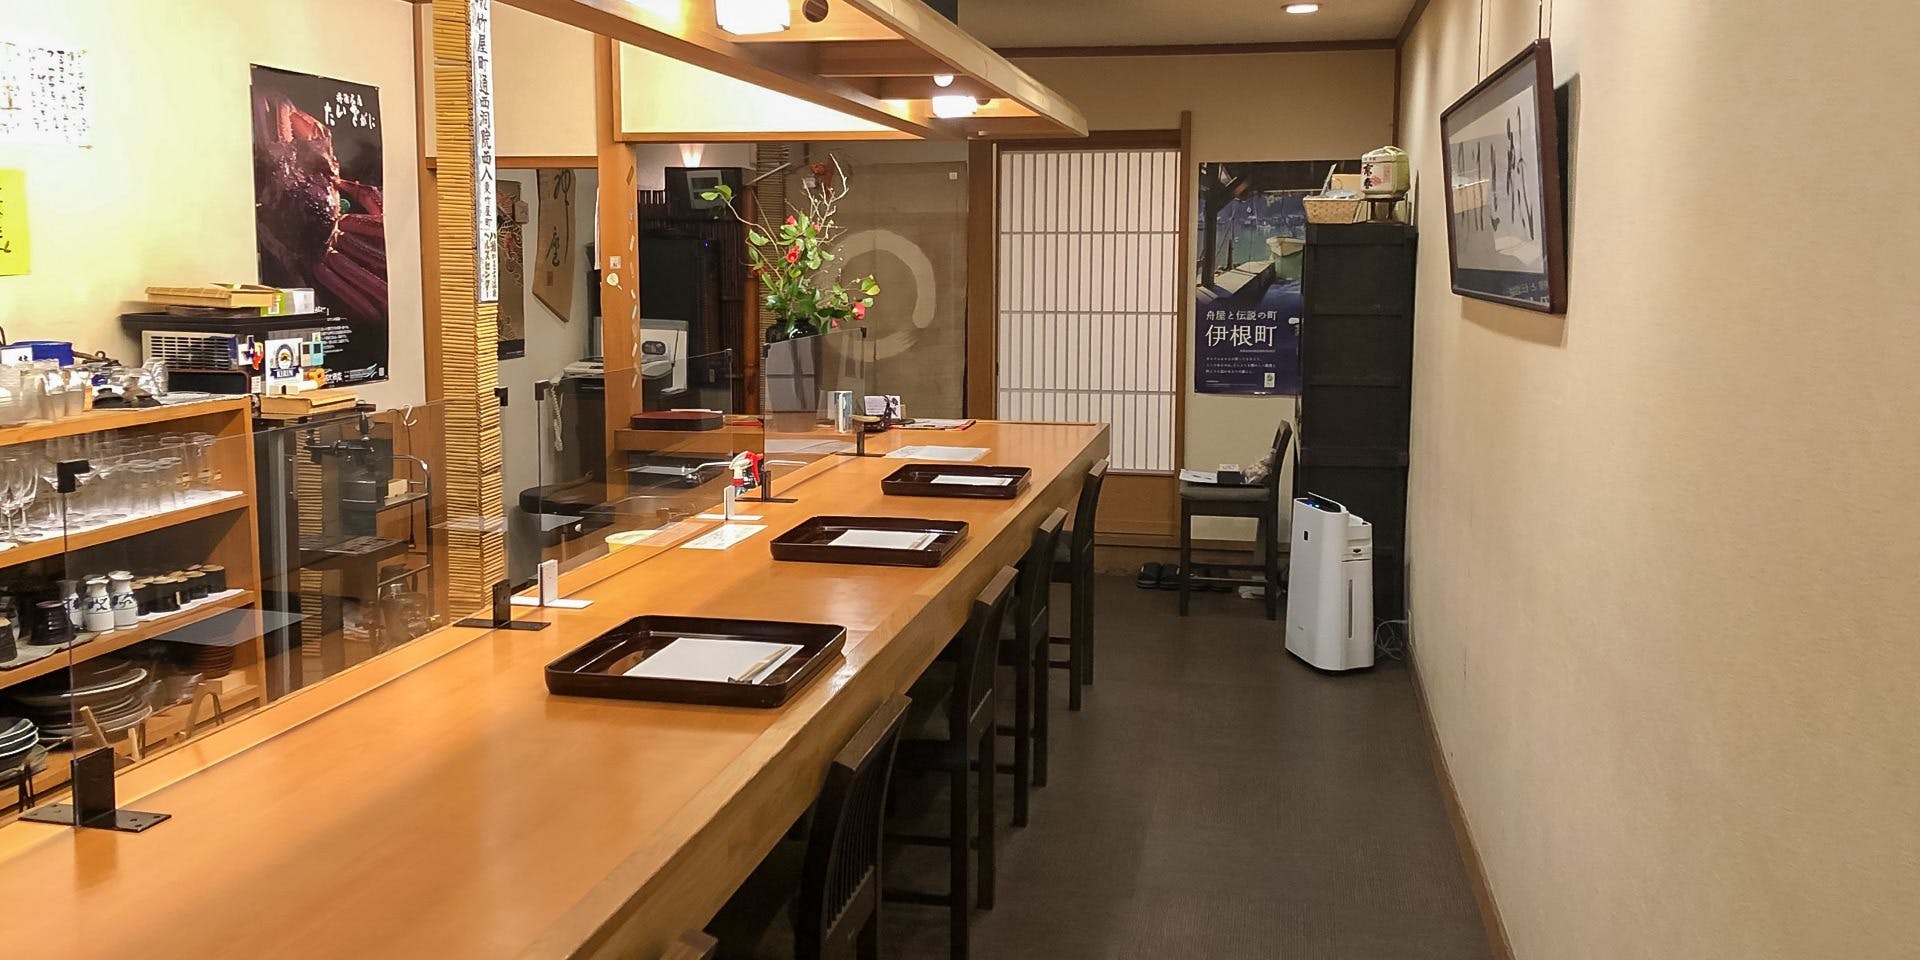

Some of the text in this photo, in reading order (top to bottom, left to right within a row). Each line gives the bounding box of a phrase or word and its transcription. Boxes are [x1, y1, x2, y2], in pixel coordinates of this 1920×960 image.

[1206, 310, 1278, 321] 舟屋と伝説の町
[1205, 324, 1278, 347] 伊根町
